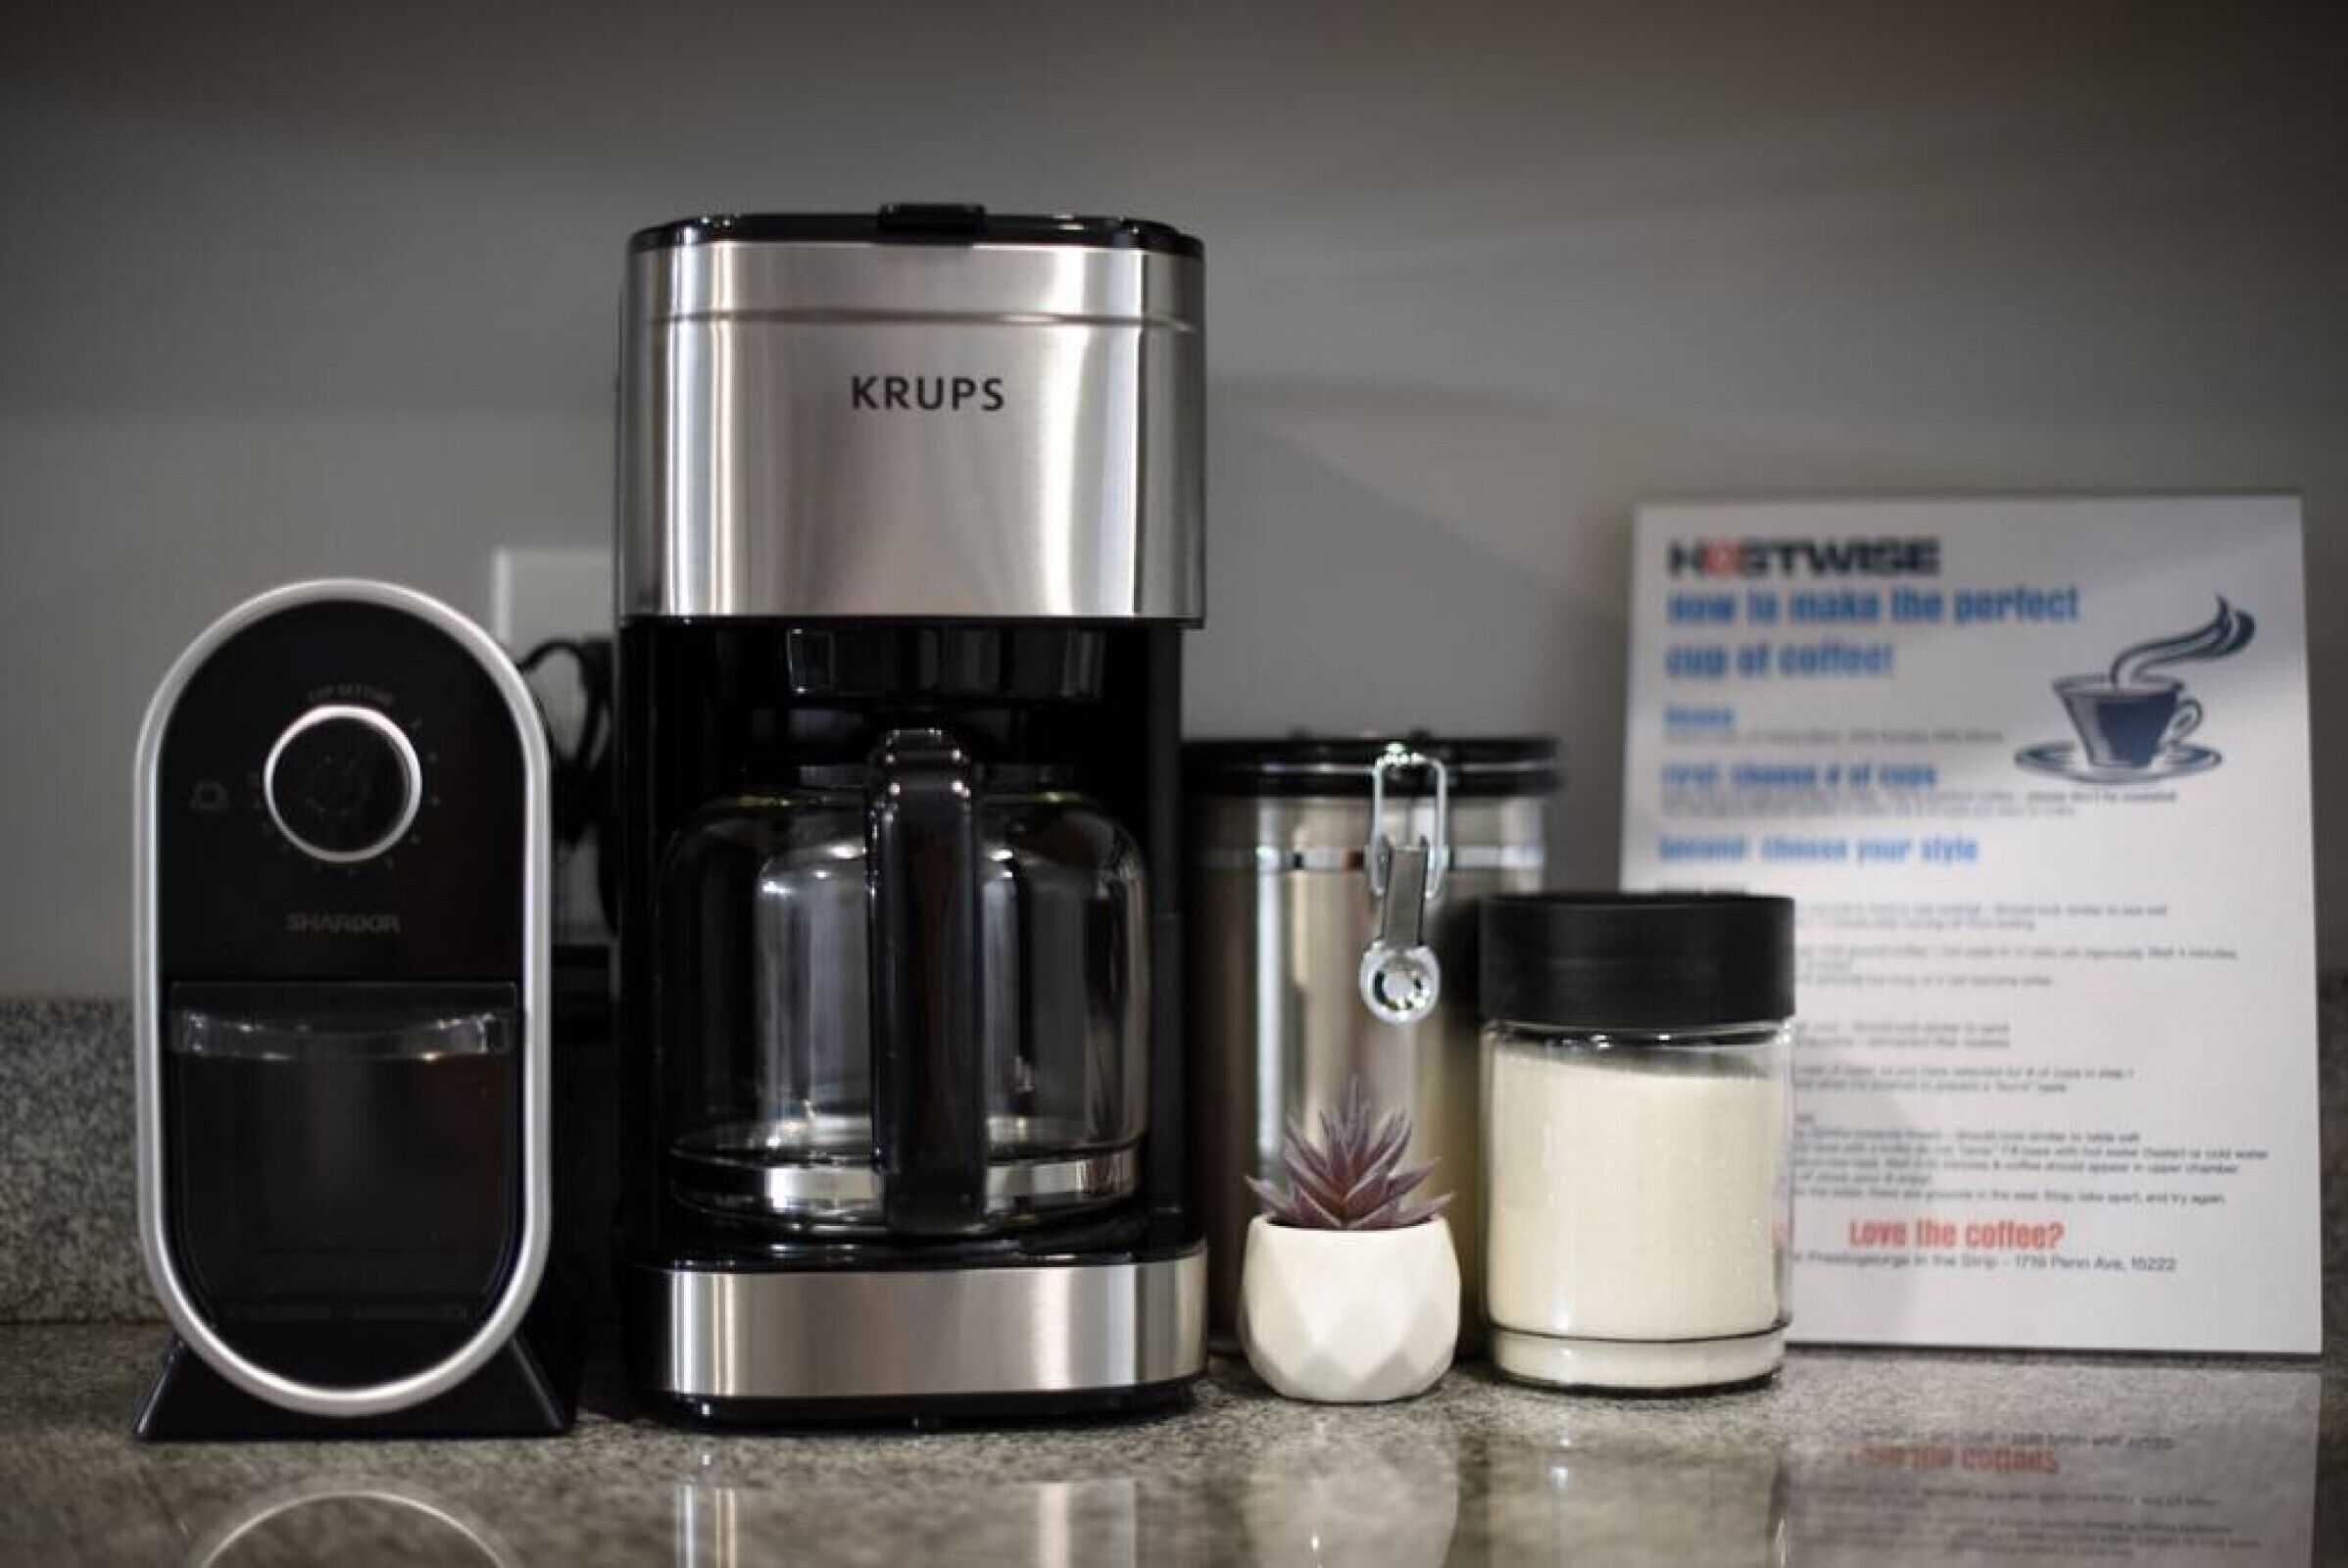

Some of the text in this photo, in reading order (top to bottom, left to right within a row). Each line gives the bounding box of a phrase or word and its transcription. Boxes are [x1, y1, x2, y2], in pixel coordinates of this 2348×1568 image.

[852, 375, 1004, 412] KRUPS
[1668, 537, 1940, 576] HOSTWISE
[1746, 589, 1780, 623] to
[1788, 588, 1881, 623] make
[1890, 587, 1943, 622] the
[1953, 586, 2079, 625] perfect
[1667, 643, 1728, 677] cup
[1737, 642, 1771, 674] of
[1879, 765, 1939, 793] cups
[1761, 838, 1846, 863] choose
[1856, 842, 1911, 867] your
[1920, 838, 1980, 867] style
[1849, 1216, 2065, 1250] Love the coffee?
[1932, 1253, 1957, 1267] the
[1962, 1253, 1998, 1272] Strip
[2051, 1255, 2089, 1270] Penn
[2130, 1256, 2177, 1272] 15222
